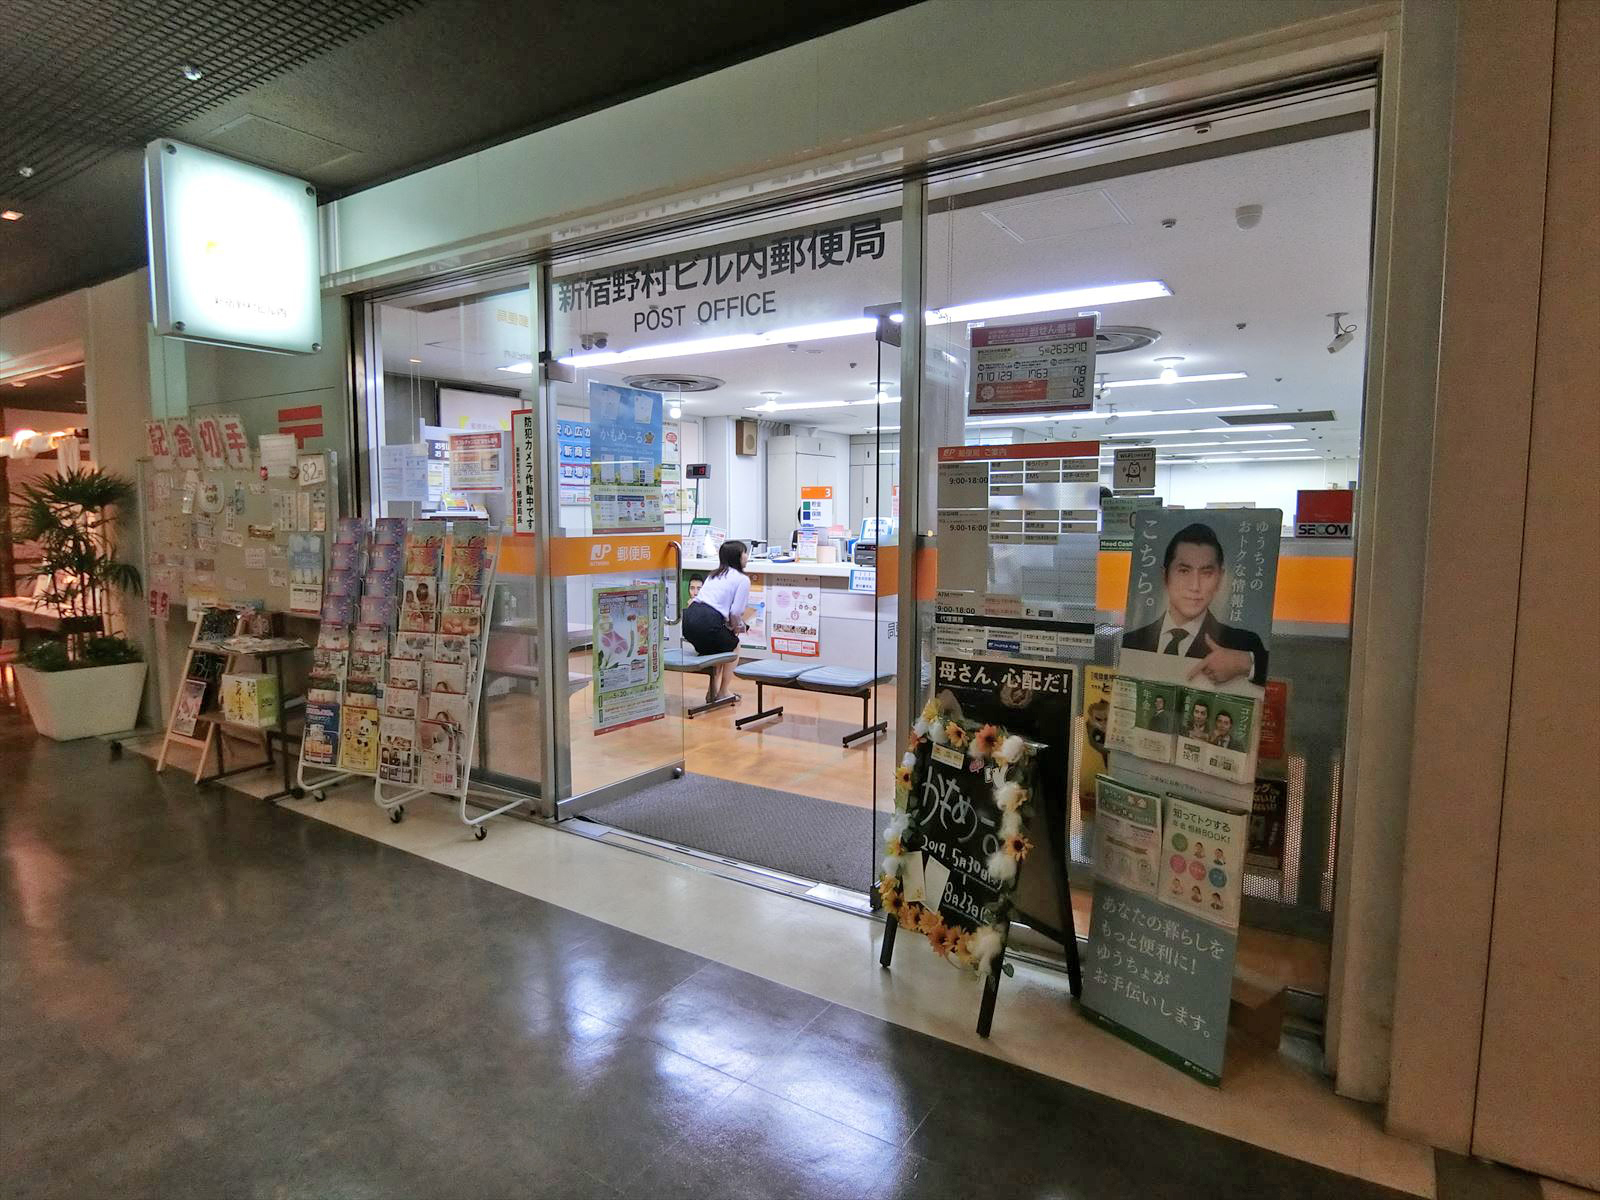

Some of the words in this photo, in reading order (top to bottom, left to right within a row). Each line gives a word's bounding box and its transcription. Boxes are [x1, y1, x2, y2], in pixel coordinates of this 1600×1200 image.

[558, 217, 886, 314] 新宿野村ビル内郵便局
[633, 305, 687, 333] POST
[697, 290, 777, 324] OFFICE
[524, 415, 536, 531] 防犯カメラ作動中です
[824, 488, 832, 498] 3
[1297, 523, 1349, 536] SECOM
[616, 544, 652, 562] 郵便局
[1102, 895, 1225, 960] あなたの暮らしを
